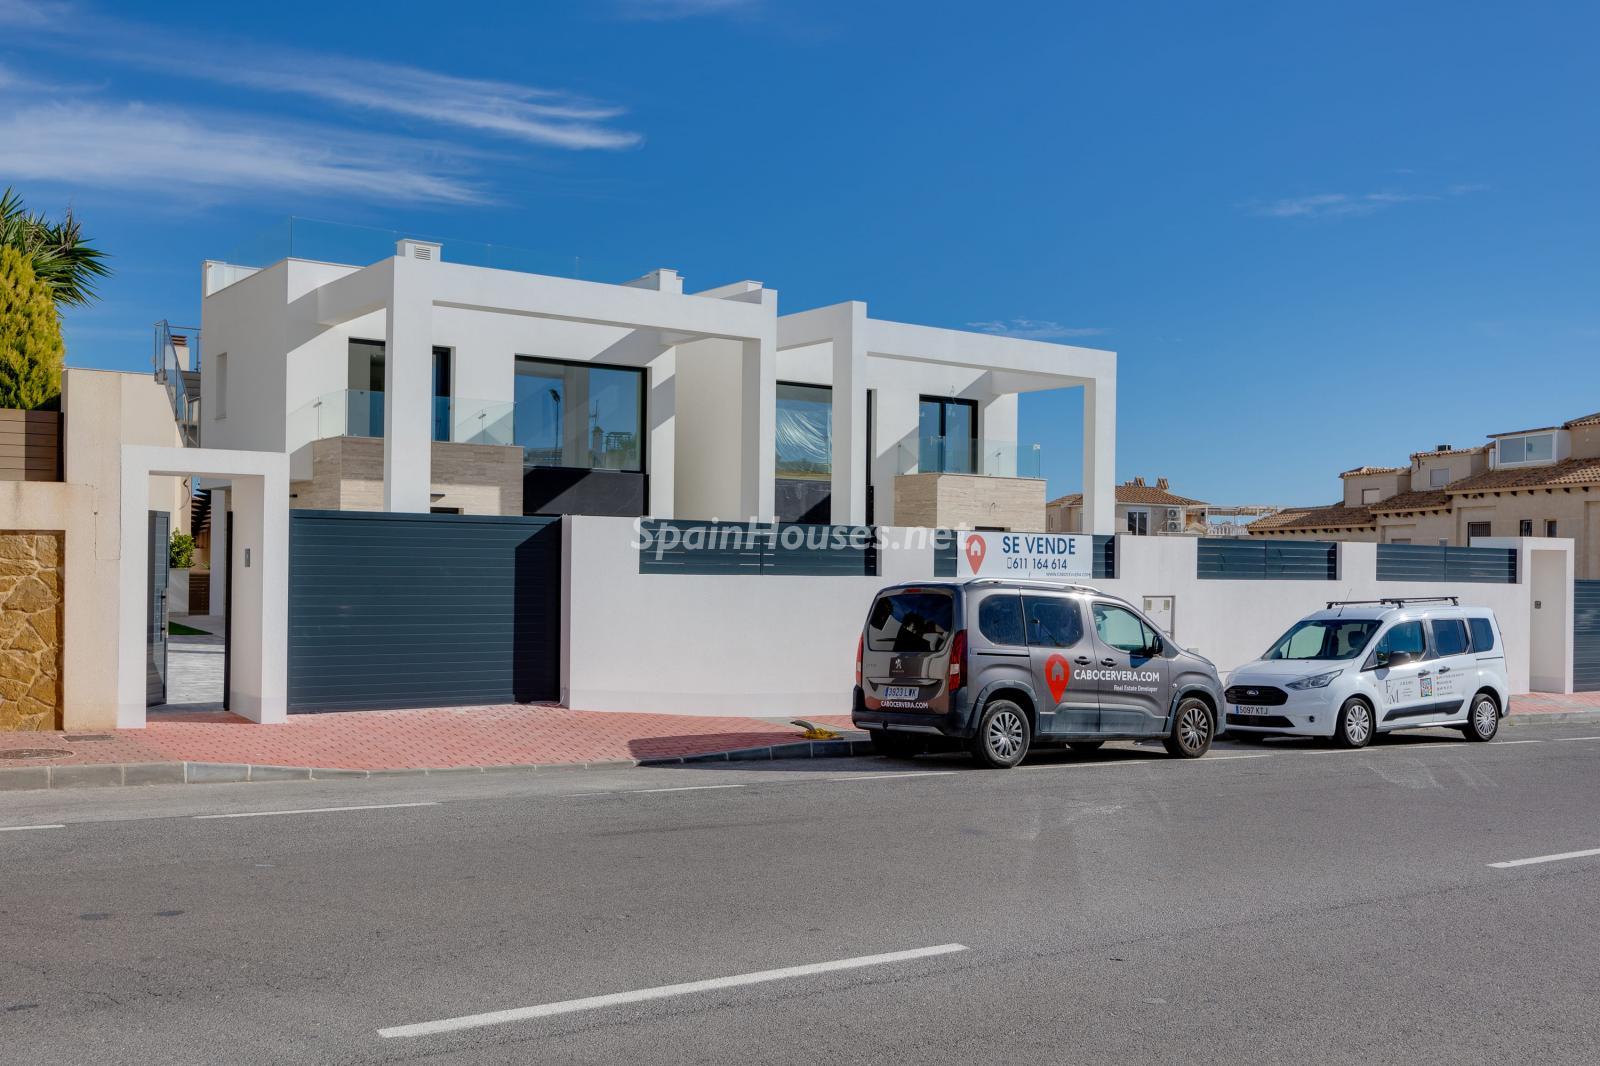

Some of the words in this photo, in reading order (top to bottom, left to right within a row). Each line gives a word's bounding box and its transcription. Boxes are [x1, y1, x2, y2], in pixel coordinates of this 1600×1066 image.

[1002, 535, 1020, 554] SE
[1025, 536, 1076, 555] VENDE
[1012, 557, 1028, 570] 611
[1032, 558, 1049, 570] 164
[1051, 558, 1067, 570] 614
[1073, 669, 1160, 682] CABOCERVERA.COM
[888, 687, 904, 697] 3923
[880, 700, 929, 709] CABOCERVERA.COM
